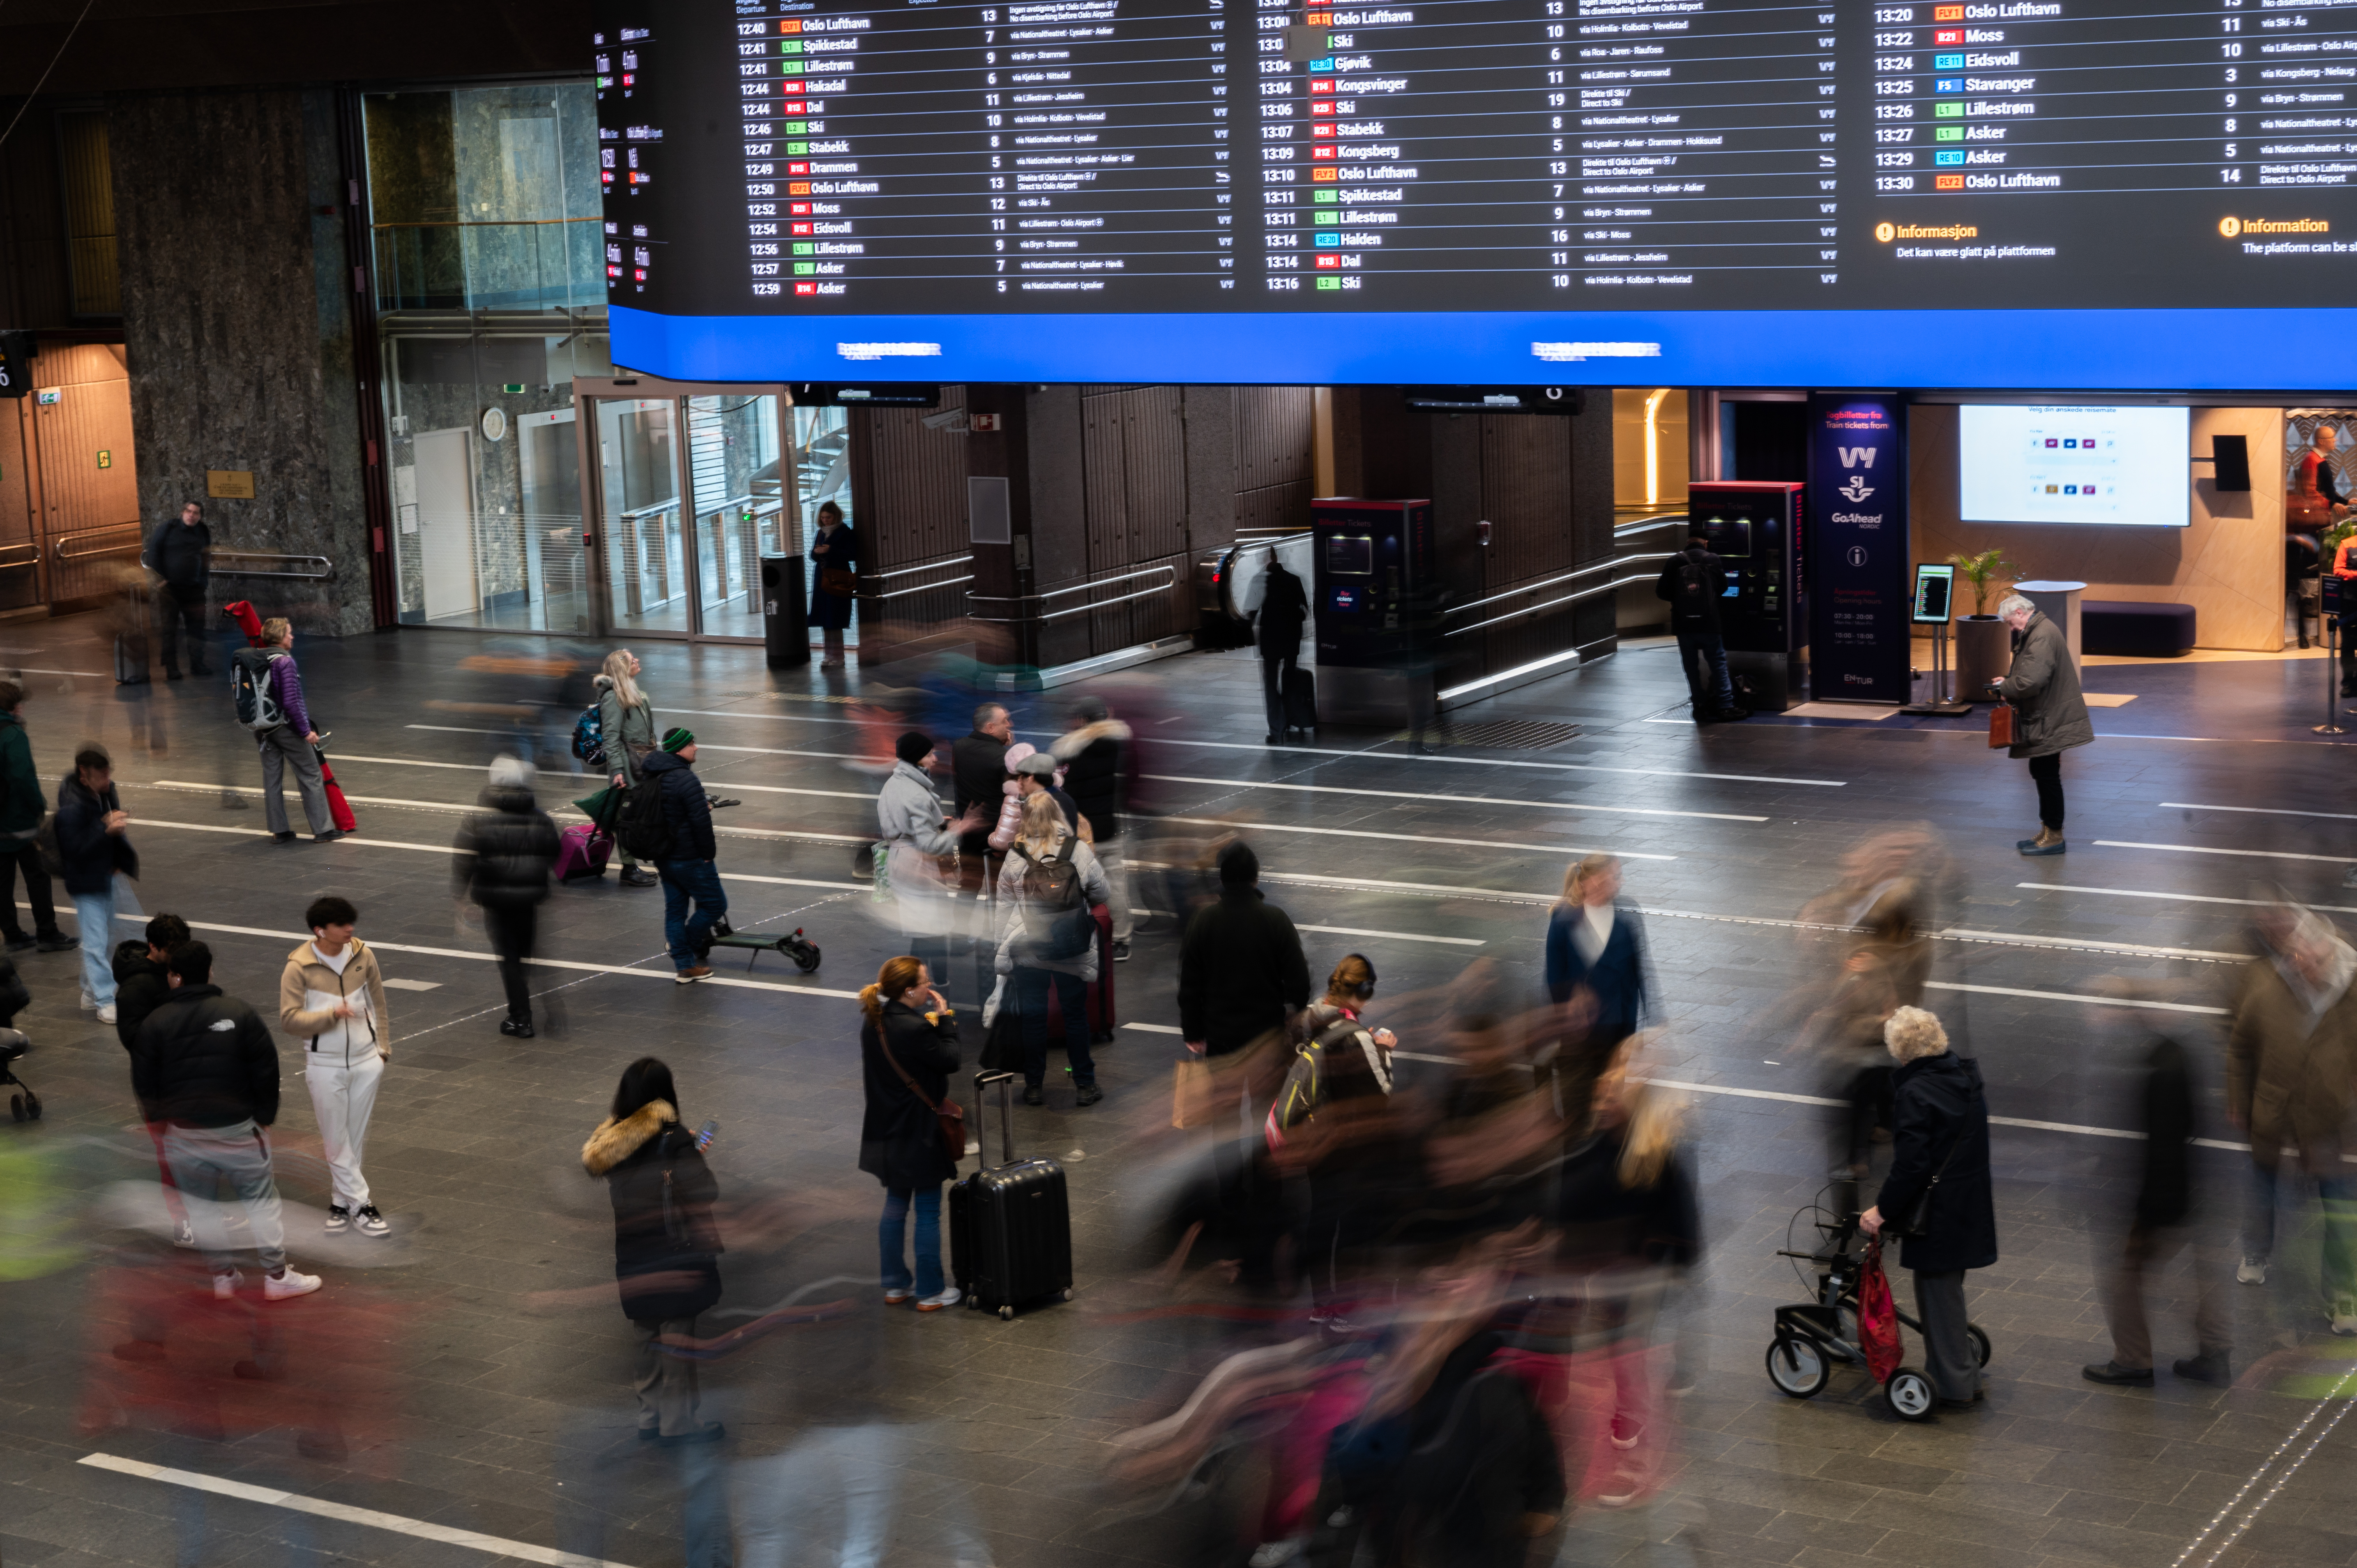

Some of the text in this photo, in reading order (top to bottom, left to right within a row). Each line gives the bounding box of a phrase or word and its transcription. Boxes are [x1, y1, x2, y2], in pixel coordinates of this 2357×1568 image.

[737, 6, 767, 14] Departure
[780, 2, 815, 11] Destination
[1875, 2, 2060, 23] 13:20 Oslo Lufthavn
[982, 10, 996, 22] 13
[1019, 13, 1058, 21] disembarking
[1092, 10, 1114, 19] Airport
[1258, 10, 1413, 28] 13:00 Oslo Lufthavn
[738, 18, 870, 34] 12:40 Oslo Lufthavn
[1020, 29, 1067, 38] Nationaltheatret
[1069, 28, 1093, 37] Lysaker
[986, 30, 995, 42] 7
[1334, 34, 1353, 48] Ski
[1875, 29, 2005, 46] 13:22 Moss
[739, 38, 858, 55] 12:41 Spikkestad
[1258, 38, 1284, 51] 13:0
[987, 52, 995, 64] 9
[1021, 52, 1035, 61] Bryn
[1038, 51, 1069, 59] Strømmen
[1875, 51, 2020, 71] 13:24 Eidsvoll
[740, 60, 854, 75] 12:41 Lillestrøm
[1259, 56, 1372, 73] 13:04 Gjøvik
[741, 83, 769, 95] 12:44
[806, 79, 846, 92] Hakadal
[1260, 79, 1408, 95] 13:04 Kongsvinger
[1875, 78, 2035, 94] 13:25 F5 Stavanger
[742, 104, 770, 115] 12:44
[807, 101, 824, 112] Dal
[1261, 101, 1355, 117] 13:06 Ski
[1875, 101, 2035, 118] 13:26 Lillestrøm
[744, 121, 825, 136] 12:46 Ski
[1262, 122, 1384, 138] 13:07 Stabekk
[1876, 125, 2007, 142] 13:27 Asker
[745, 141, 850, 155] 12:47 Stabekk
[1262, 145, 1399, 160] 13:09 Kongsberg
[1876, 150, 2007, 166] 13:29 Asker
[746, 162, 858, 175] 12:49 Drammen
[1263, 167, 1418, 182] 13:10 Oslo Lufthavn
[747, 181, 879, 195] 12:50 Oslo Lufthavn
[1876, 173, 2060, 190] 13:30 Oslo Lufthavn
[1264, 188, 1403, 204] 13:11 Spikkestad
[748, 203, 841, 215] 12:52 Moss
[991, 198, 1006, 210] 12
[1265, 211, 1398, 225] 13:11 Lillestrøm
[749, 221, 852, 235] 12:54 Eidsvoll
[1897, 224, 1977, 240] Informasjon
[2243, 218, 2329, 233] Information
[1265, 233, 1382, 247] 13:14 Halden
[751, 242, 864, 255] 12:56 Lillestrøm
[1897, 245, 2055, 259] Det kan være glatt på plattformen
[2242, 242, 2348, 255] The platform can be
[1266, 254, 1361, 268] 13:14 Dal
[752, 262, 845, 275] 12:57 Asker
[753, 283, 780, 295] 12:59
[816, 282, 846, 294] Asker
[1267, 276, 1361, 290] 13:16 Ski
[1826, 411, 1869, 420] Togbilletter
[1850, 476, 1864, 489] SJ
[1832, 512, 1883, 523] GoAhead
